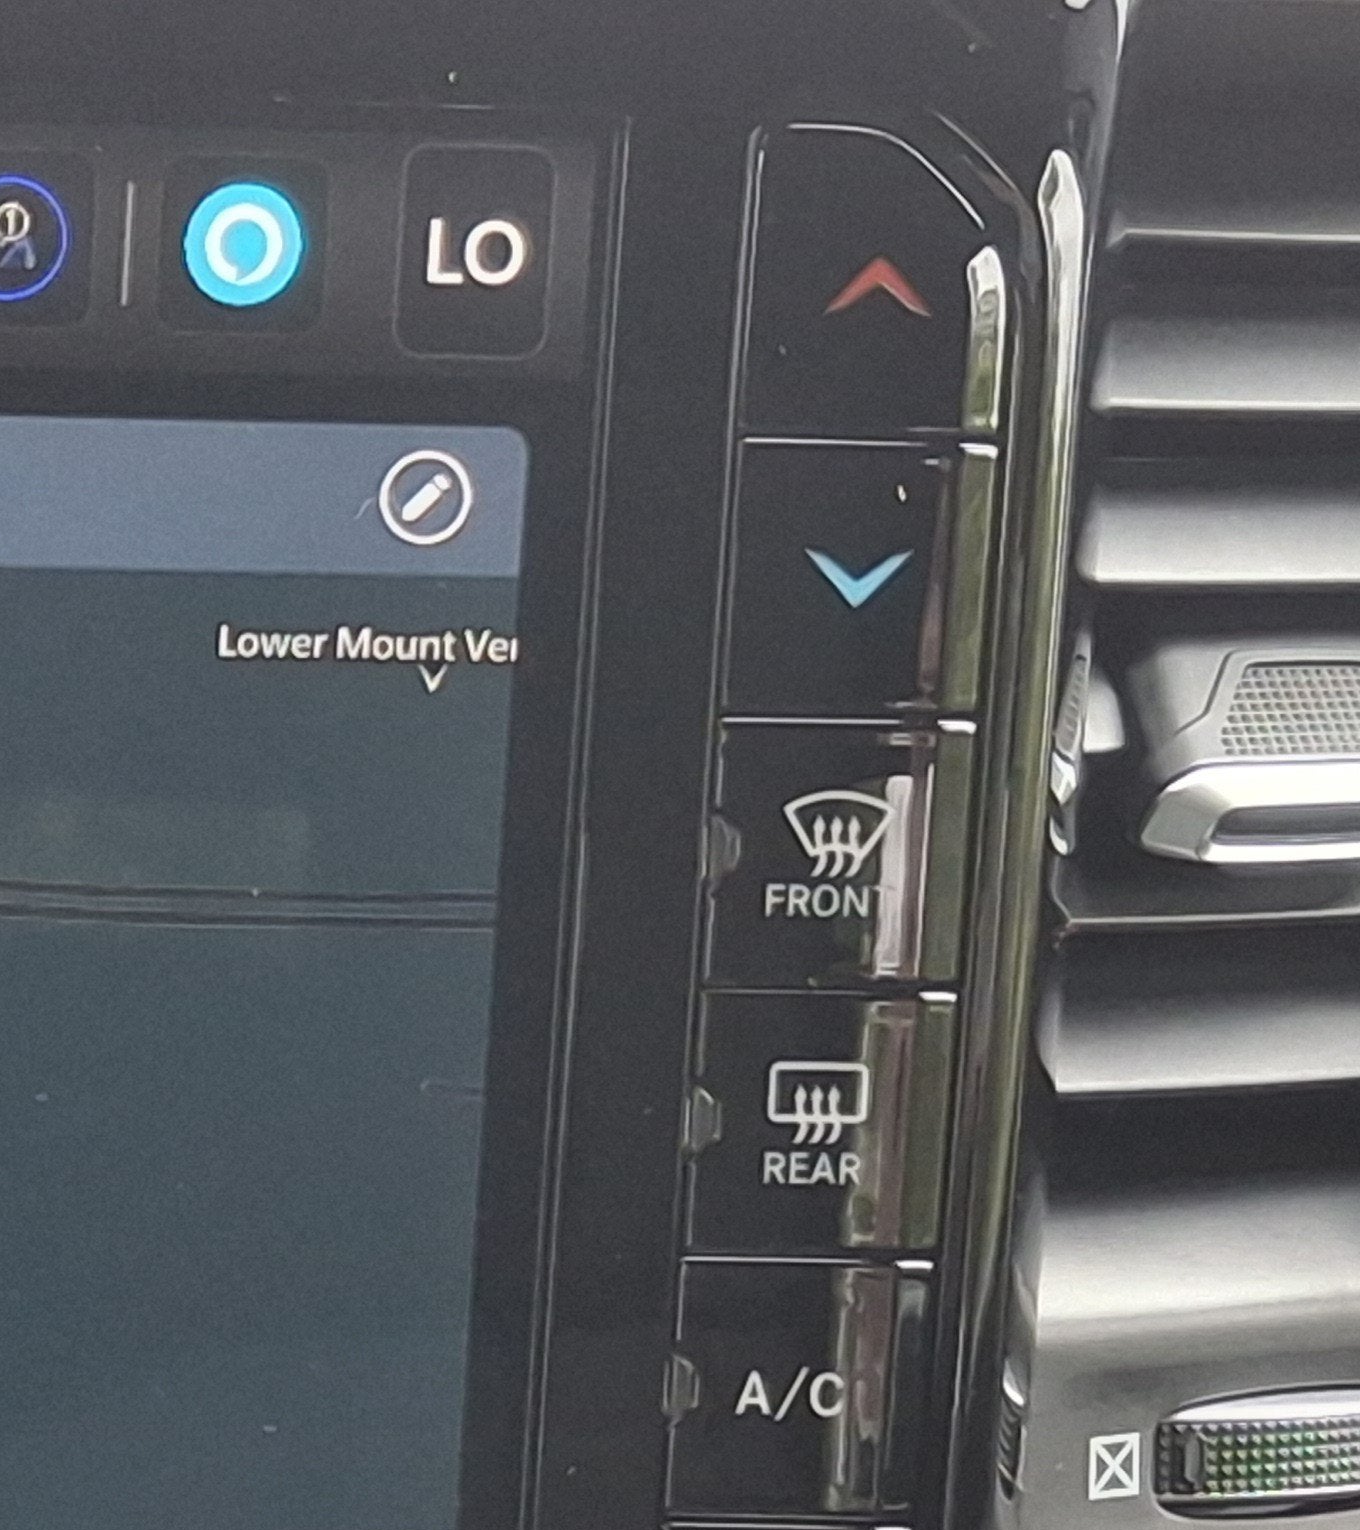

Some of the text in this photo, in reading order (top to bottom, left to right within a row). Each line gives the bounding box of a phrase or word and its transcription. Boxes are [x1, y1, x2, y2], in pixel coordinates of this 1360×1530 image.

[425, 216, 525, 287] LO
[217, 624, 327, 662] Lower
[335, 627, 458, 664] Mount
[763, 1150, 861, 1186] REAR
[735, 1365, 845, 1420] A/C
